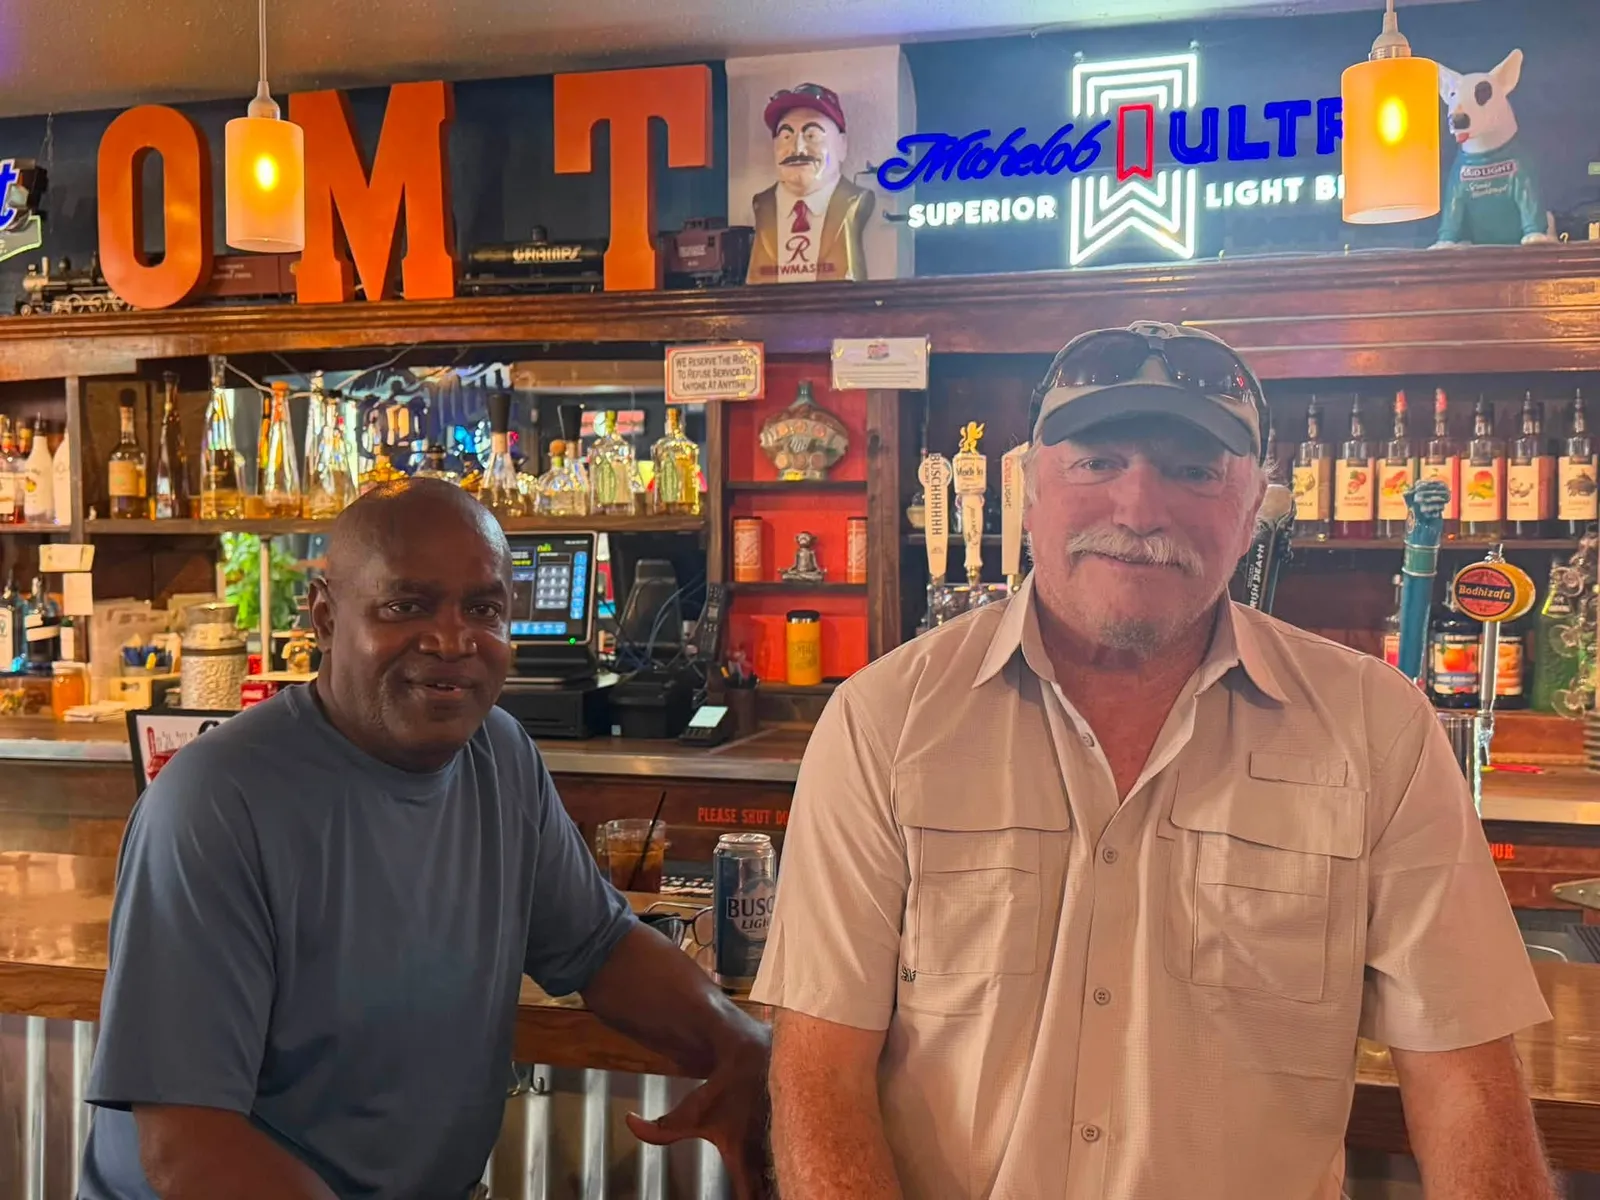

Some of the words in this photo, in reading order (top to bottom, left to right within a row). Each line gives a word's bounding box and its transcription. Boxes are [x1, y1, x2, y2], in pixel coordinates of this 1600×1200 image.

[876, 119, 1111, 191] Michelob
[1168, 97, 1343, 165] ULTR
[907, 195, 1057, 228] SUPERIOR
[1205, 177, 1302, 208] LIGHT
[785, 235, 810, 263] R
[676, 357, 687, 368] WE
[688, 356, 716, 366] RESERVE
[718, 355, 731, 364] THE
[678, 369, 686, 379] TO
[712, 367, 739, 377] SERVICE
[741, 366, 751, 375] TO
[1253, 543, 1265, 583] DEATH
[1458, 584, 1511, 600] Bodhizafa
[698, 807, 737, 823] PLEASE
[741, 809, 771, 824] SHUT
[728, 895, 775, 918] BUSC
[741, 918, 769, 929] LIGH
